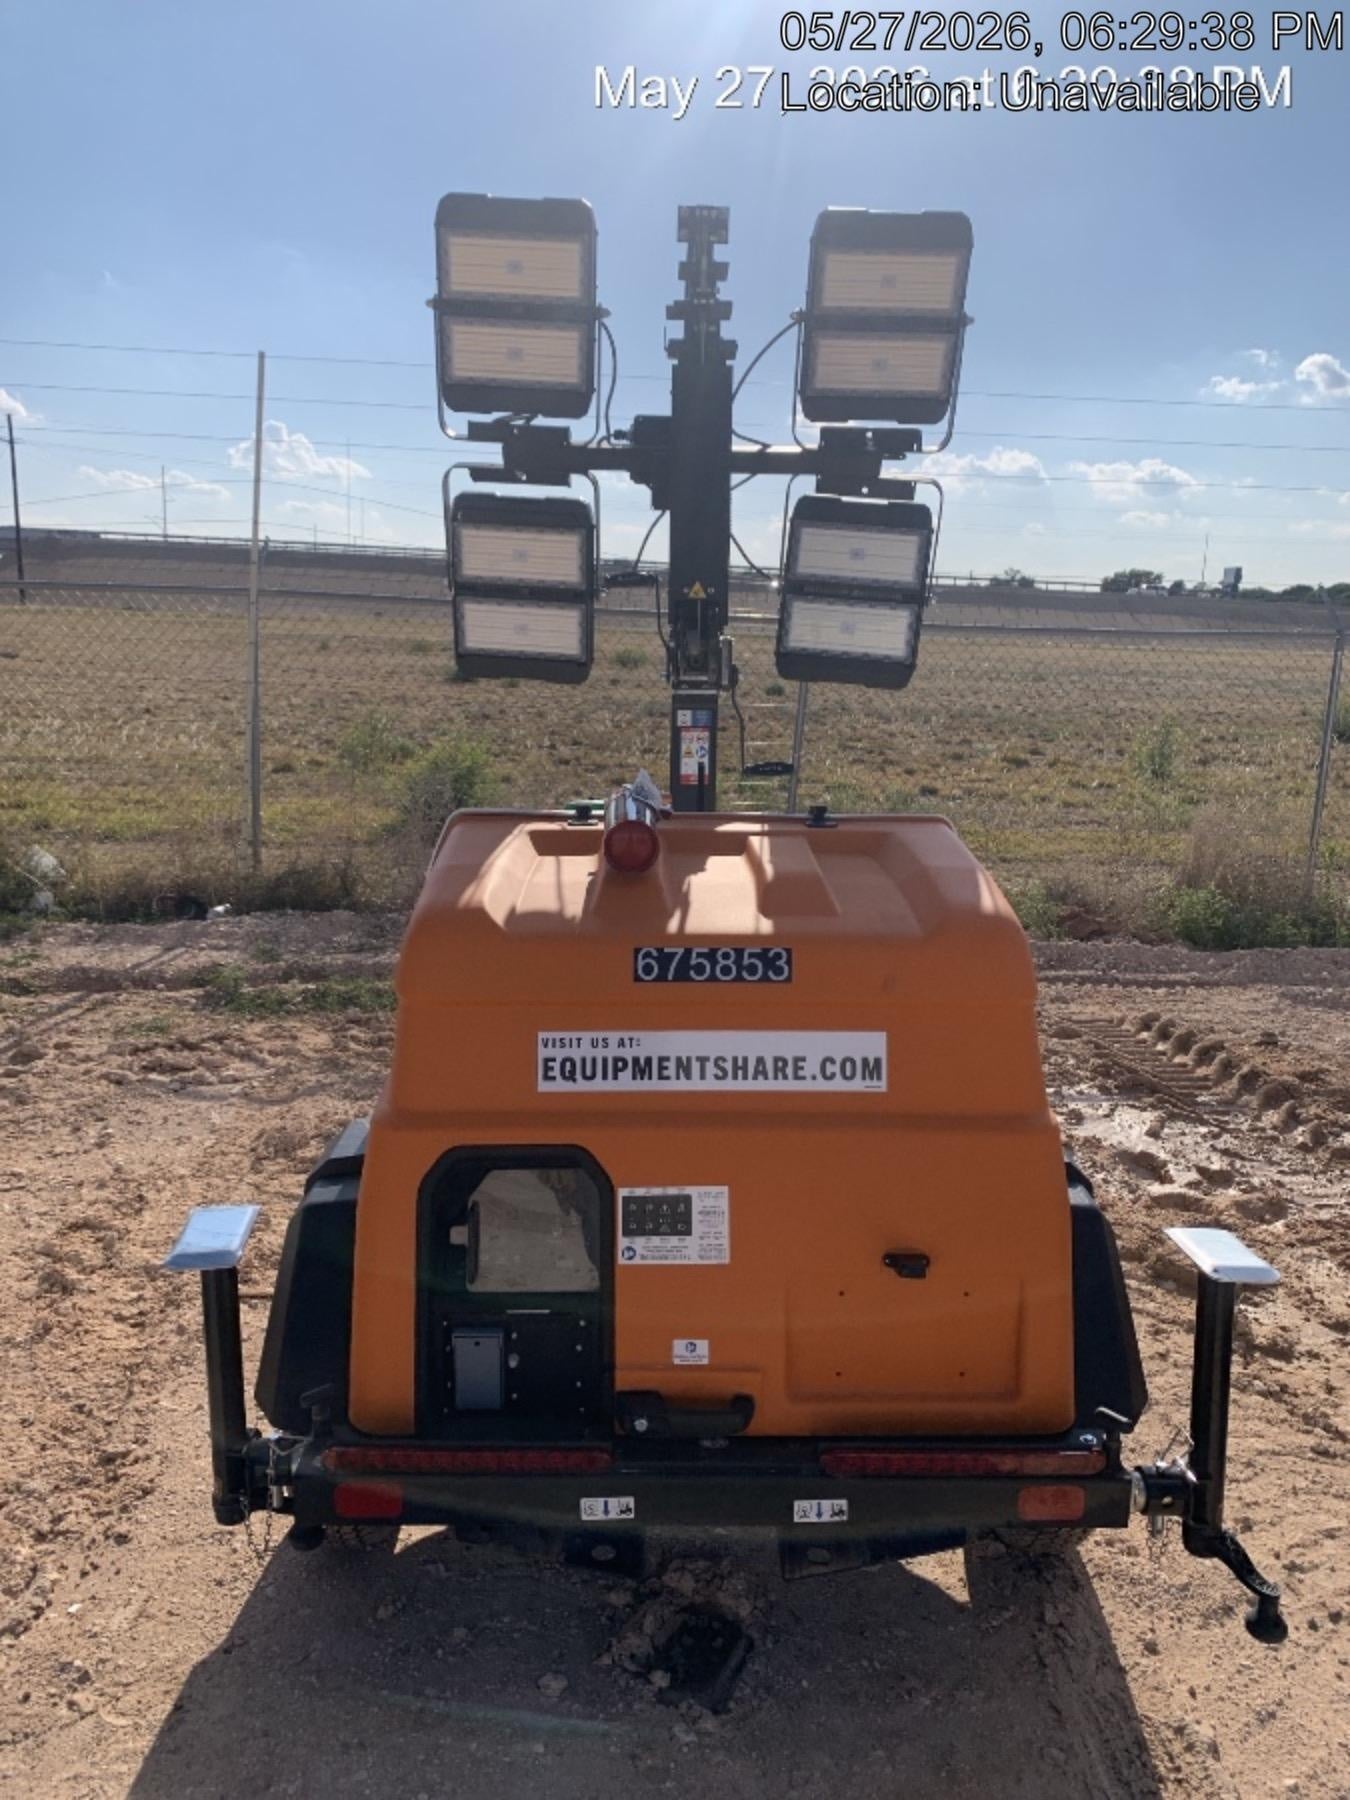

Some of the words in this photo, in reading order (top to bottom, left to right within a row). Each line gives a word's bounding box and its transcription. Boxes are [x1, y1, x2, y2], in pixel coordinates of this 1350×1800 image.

[636, 948, 790, 982] 675853
[541, 1037, 583, 1049] VISIT
[591, 1037, 610, 1049] US
[617, 1037, 641, 1049] AT:
[541, 1055, 883, 1084] EQUIPMENTSHARE.COM
